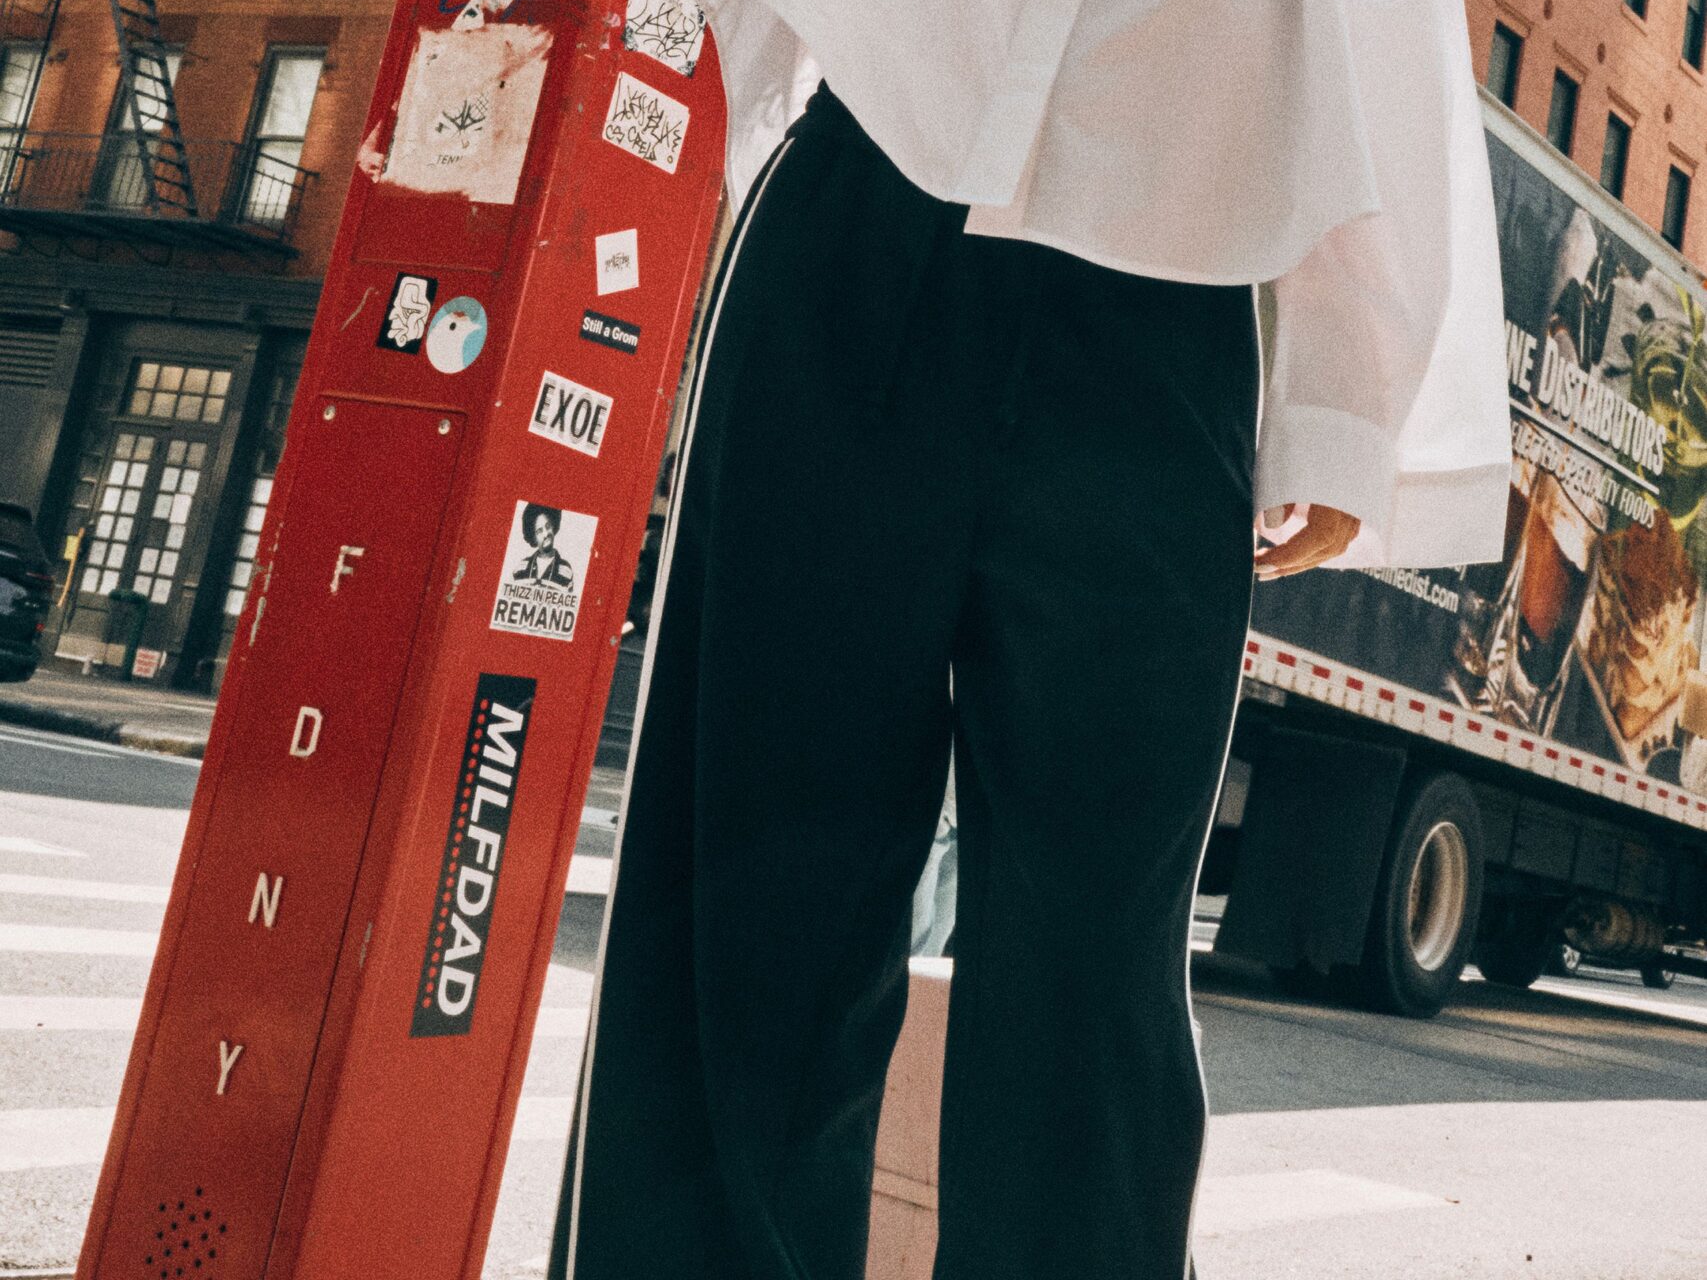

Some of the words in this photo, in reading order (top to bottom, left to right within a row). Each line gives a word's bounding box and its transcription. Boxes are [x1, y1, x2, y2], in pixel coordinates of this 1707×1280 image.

[582, 316, 603, 335] Still
[603, 326, 610, 337] a
[612, 326, 638, 347] Grom
[535, 382, 607, 445] EXOE
[1538, 334, 1667, 476] DISTRIBUTORS
[1619, 487, 1656, 529] FOODS
[494, 598, 576, 633] REMAND
[503, 583, 532, 600] THIZZ
[533, 588, 544, 602] IN
[545, 591, 578, 608] PEACE
[437, 702, 524, 1016] MILFDAD
